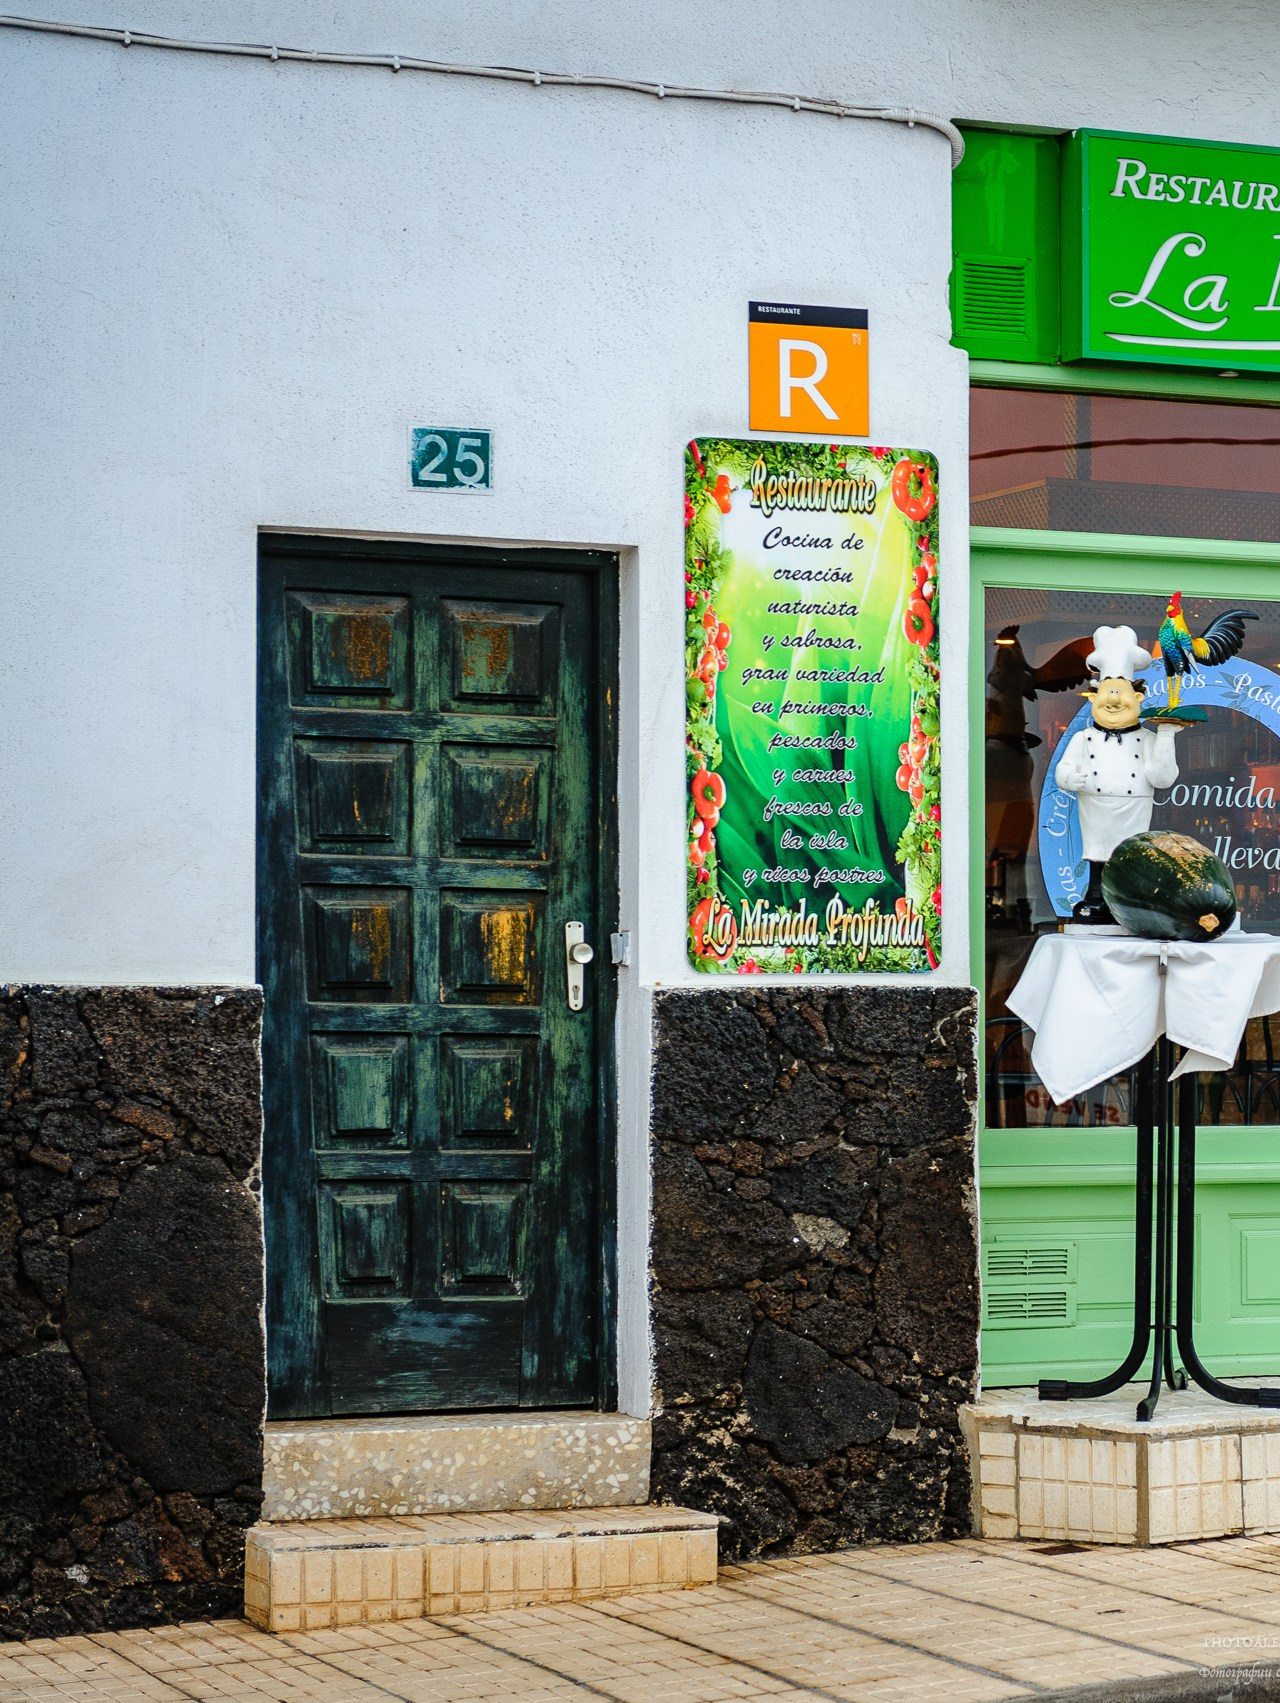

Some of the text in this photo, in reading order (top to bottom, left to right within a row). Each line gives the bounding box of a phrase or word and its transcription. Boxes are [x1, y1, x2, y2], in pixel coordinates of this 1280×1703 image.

[1108, 231, 1230, 332] La
[757, 305, 801, 315] RESTAURANTE
[778, 338, 840, 421] R
[418, 433, 485, 485] 25
[749, 453, 877, 517] Restaurante
[762, 526, 864, 551] Cocina de
[773, 567, 854, 584] creación
[767, 598, 860, 618] naturista
[762, 628, 863, 652] y sabrosa,
[741, 665, 886, 687] gran variedad
[751, 698, 874, 719] en primeros,
[767, 730, 858, 753] pescados
[772, 766, 856, 784] y carnes
[763, 797, 863, 822] frescos de
[780, 829, 849, 850] la isla
[743, 865, 886, 889] y ricos postres
[702, 892, 926, 963] La Mirada Profunda
